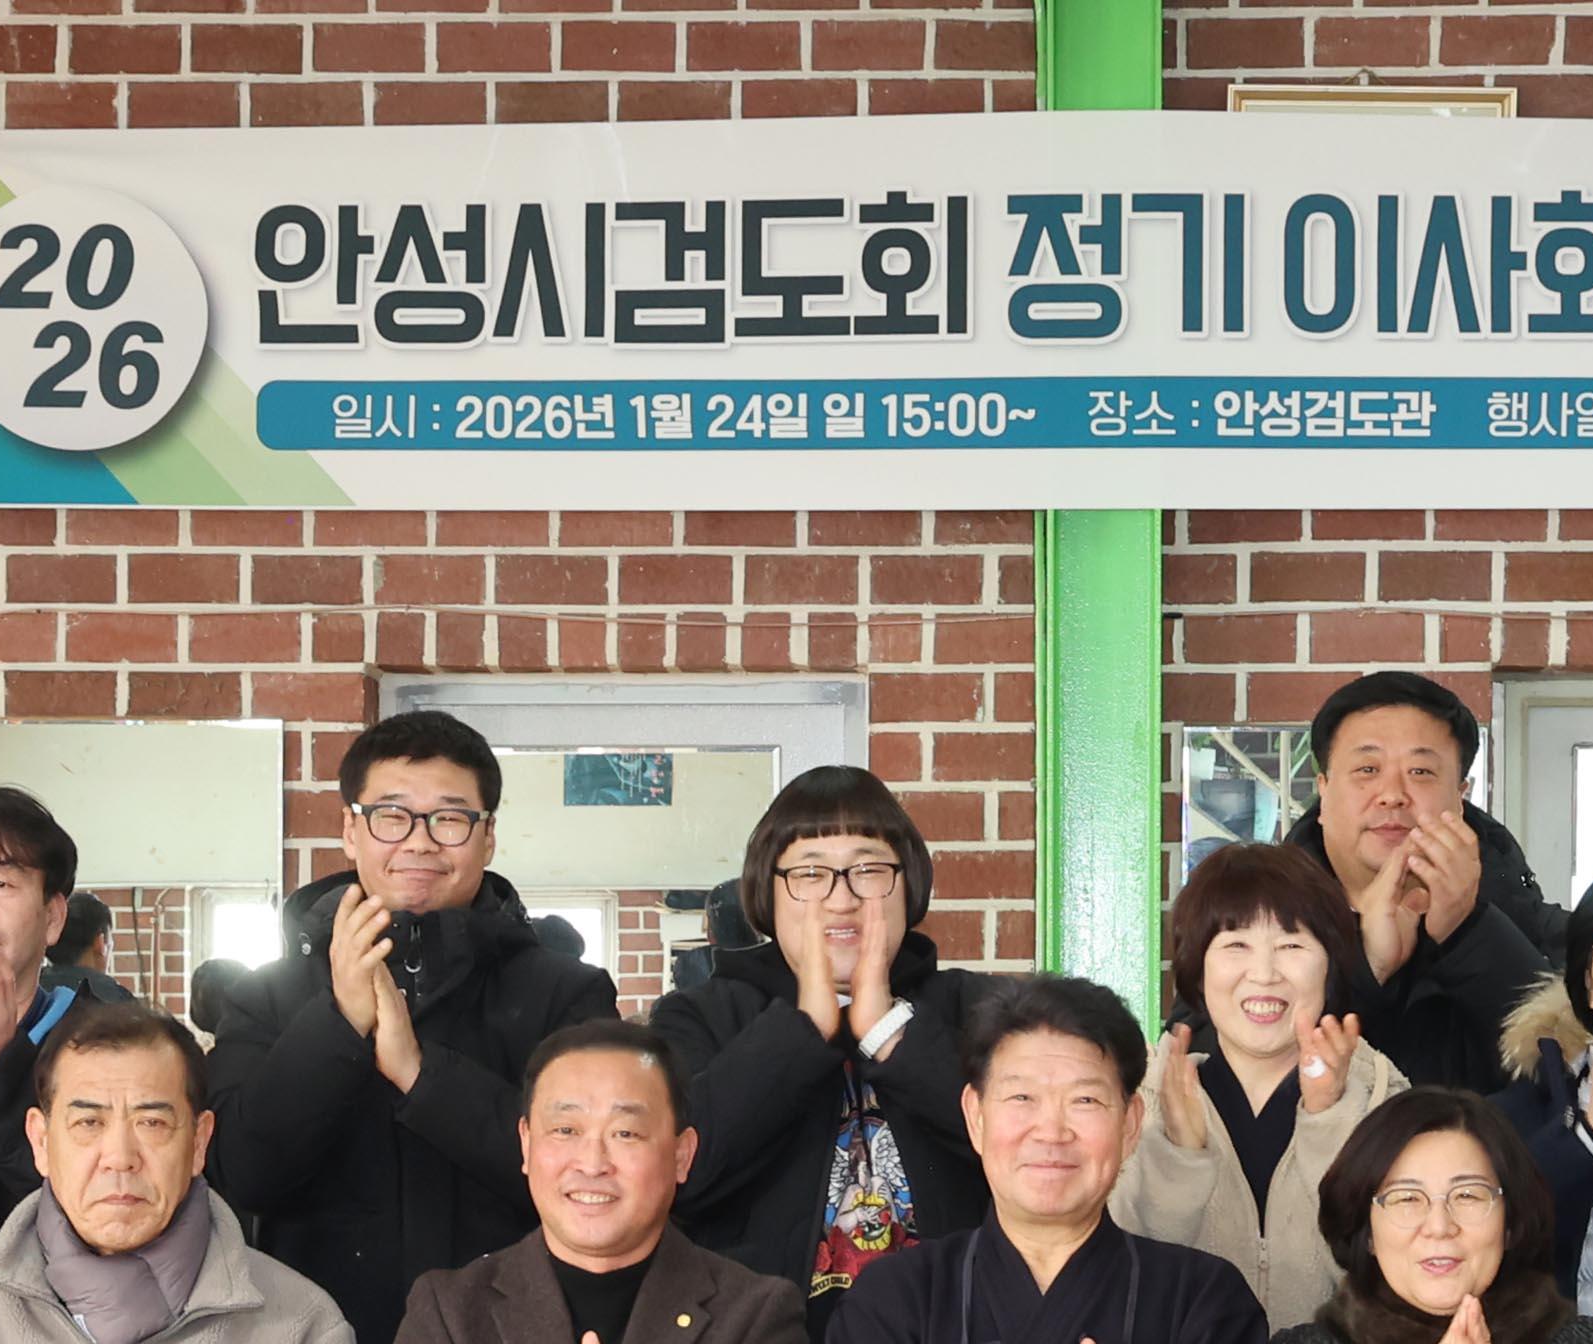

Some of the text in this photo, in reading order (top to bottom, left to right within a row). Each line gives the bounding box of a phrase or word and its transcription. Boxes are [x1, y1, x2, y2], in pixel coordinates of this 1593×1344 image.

[254, 191, 972, 344] 안성시검도회
[1007, 193, 1245, 339] 정기
[22, 320, 164, 409] 26
[332, 394, 416, 439] 일시
[455, 394, 614, 439] 2026년
[629, 392, 693, 440] 1월
[706, 393, 809, 439] 24일
[823, 392, 865, 438] 일
[881, 393, 1036, 438] 15:00~
[1087, 390, 1176, 437] 장소
[1213, 390, 1437, 437] 안성검도관
